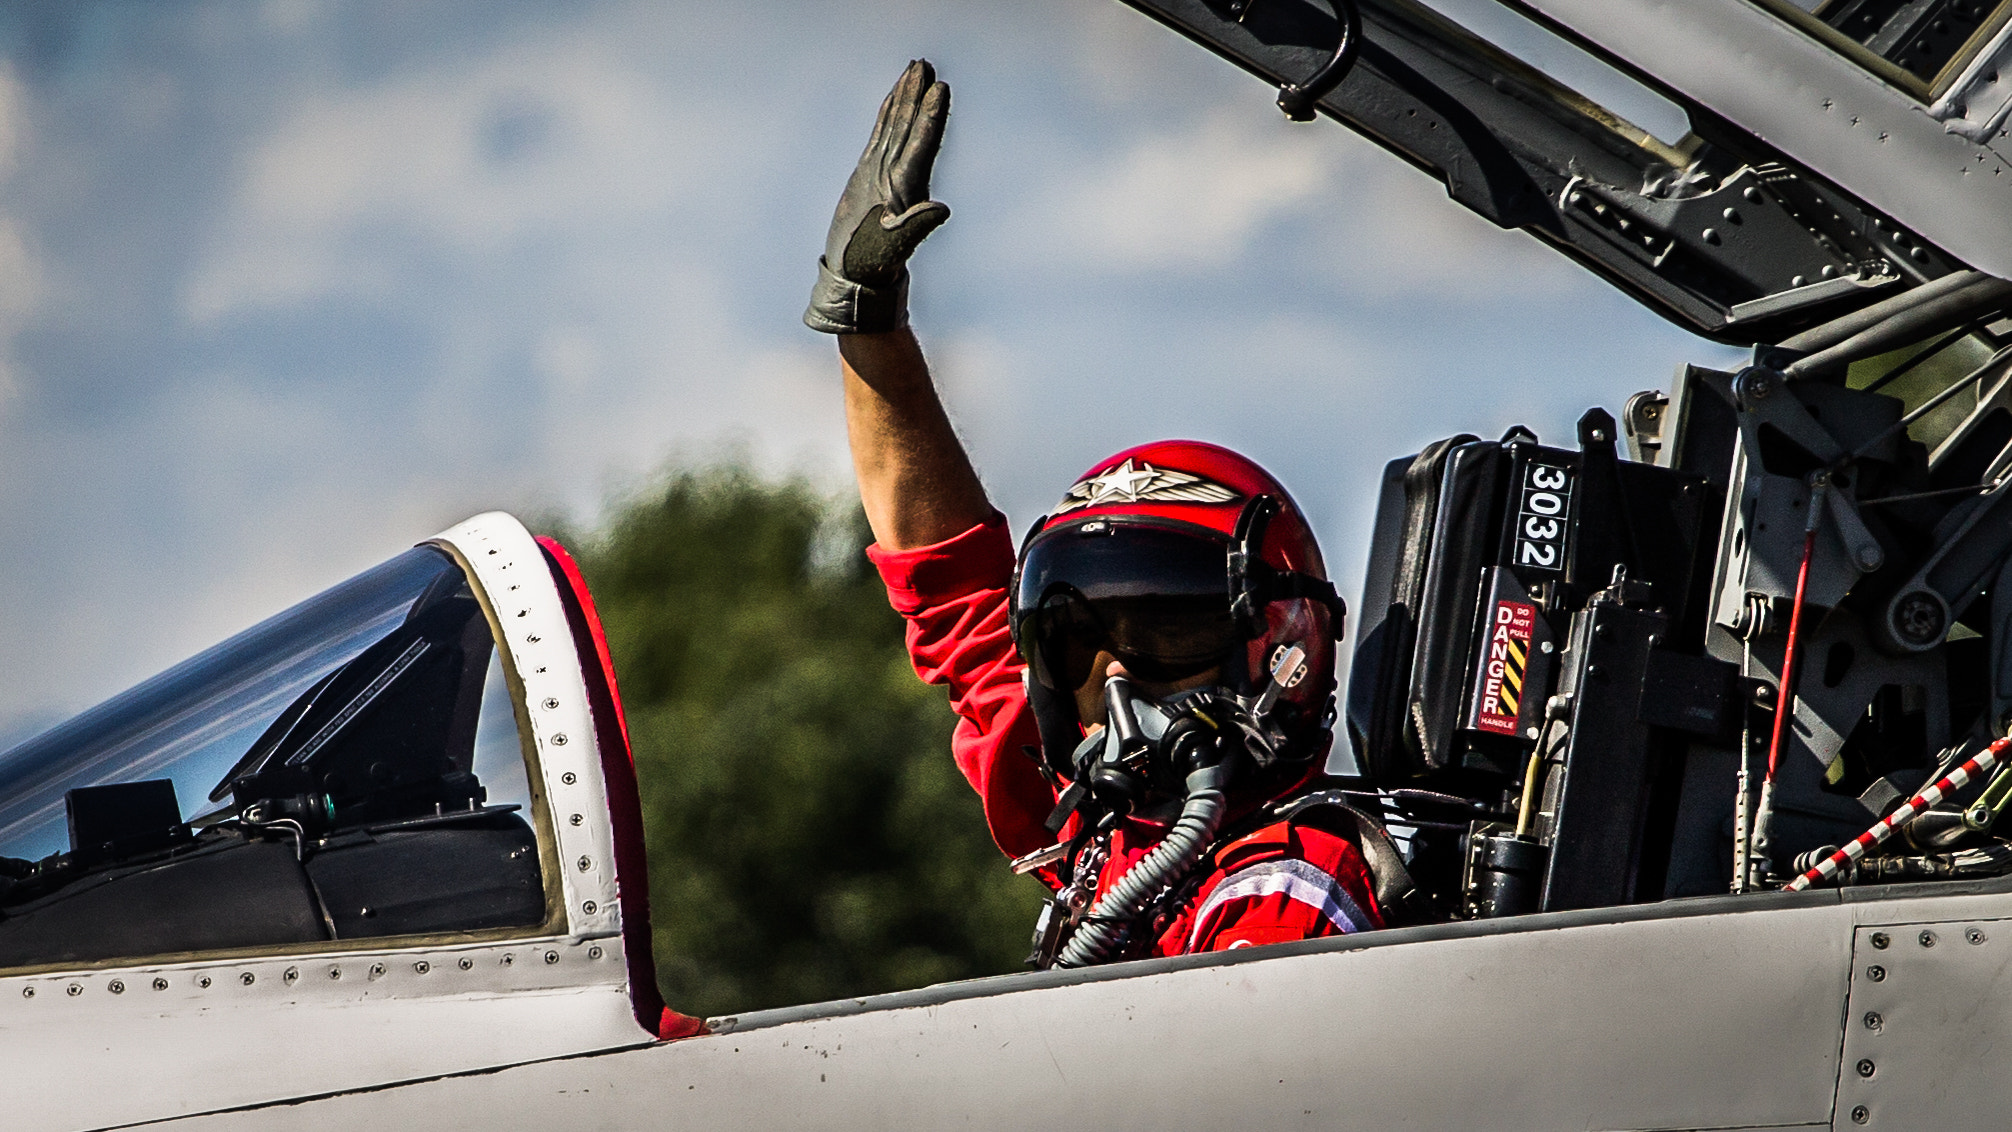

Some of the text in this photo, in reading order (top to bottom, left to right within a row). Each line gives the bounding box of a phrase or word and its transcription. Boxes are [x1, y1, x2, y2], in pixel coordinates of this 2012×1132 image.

[1522, 467, 1565, 566] 3032
[1517, 607, 1530, 616] DO
[1512, 618, 1530, 628] NOT
[1509, 629, 1529, 638] PULL
[1483, 606, 1513, 715] DANGER
[1481, 717, 1514, 730] HANDLE
